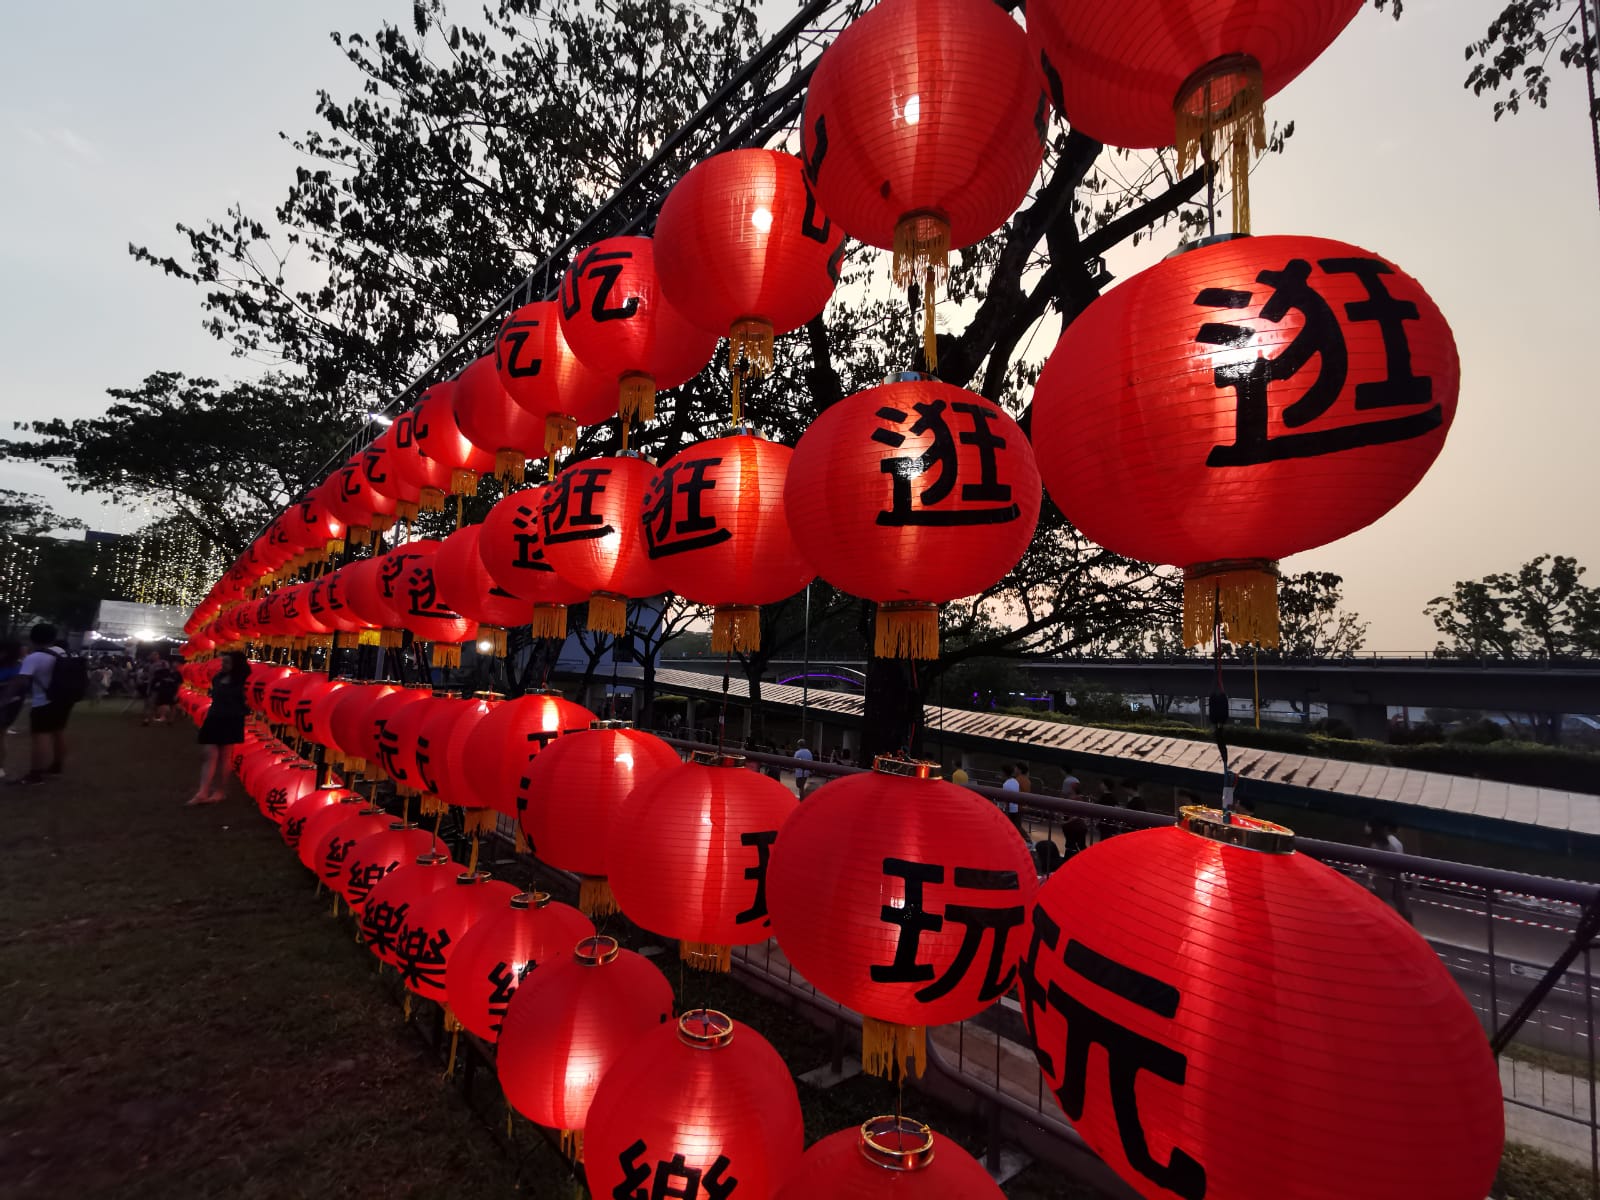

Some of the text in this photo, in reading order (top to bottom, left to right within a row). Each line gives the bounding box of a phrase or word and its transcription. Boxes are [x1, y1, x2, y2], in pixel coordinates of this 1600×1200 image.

[561, 247, 640, 323] 吃
[1194, 259, 1443, 468] 逛
[541, 468, 615, 546] 逛
[642, 457, 733, 560] 逛
[874, 399, 1021, 527] 逛
[396, 923, 452, 989] 樂
[869, 857, 1026, 1003] 玩
[1018, 902, 1208, 1200] 玩
